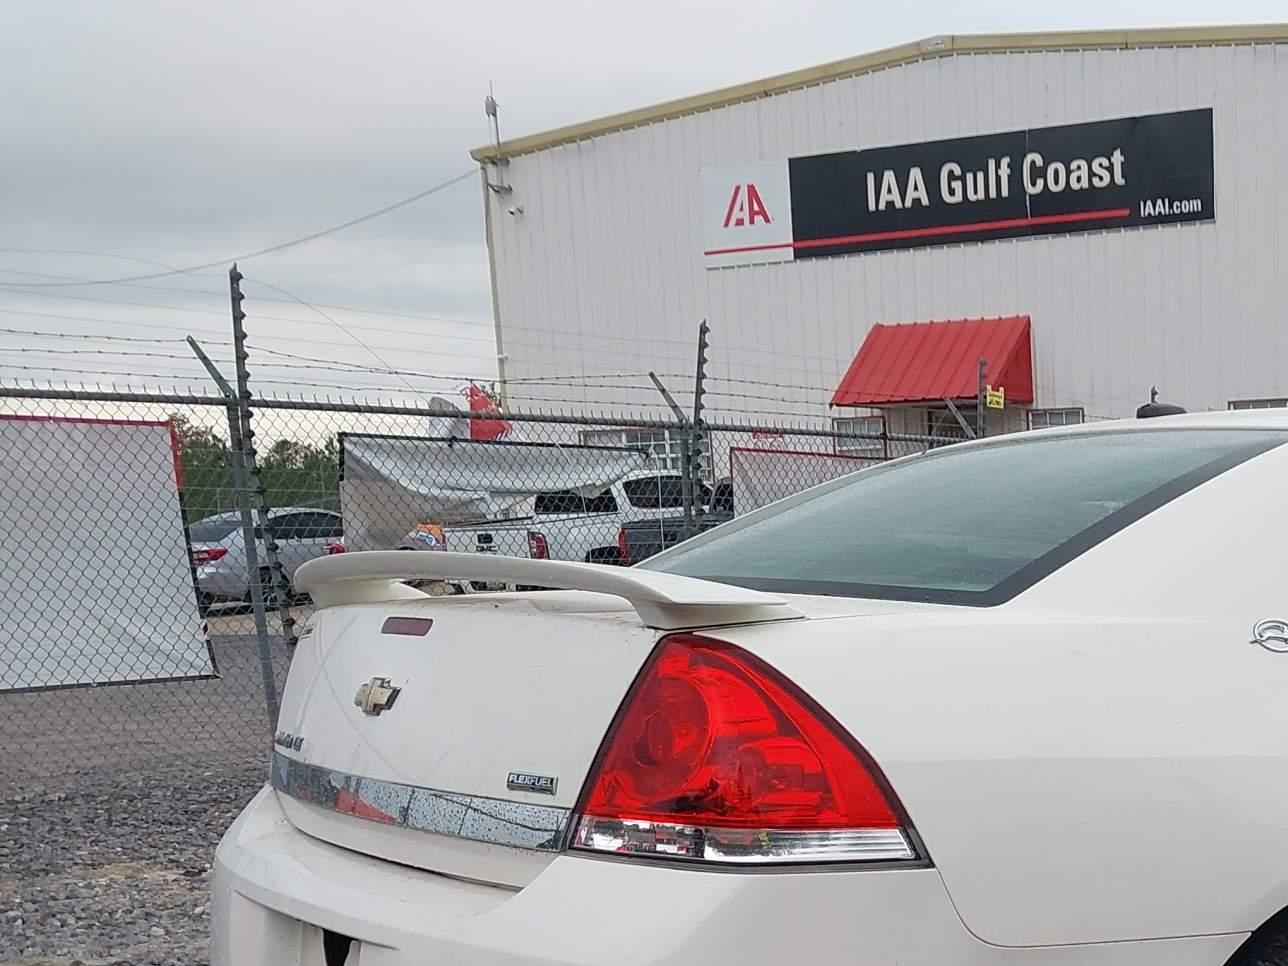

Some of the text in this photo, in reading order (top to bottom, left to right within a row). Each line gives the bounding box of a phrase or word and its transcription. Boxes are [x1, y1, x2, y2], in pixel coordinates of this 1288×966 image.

[866, 147, 1126, 212] IAA Gulf Coast
[1140, 198, 1202, 217] IAAI.com
[509, 773, 554, 787] FLEXFUEL
